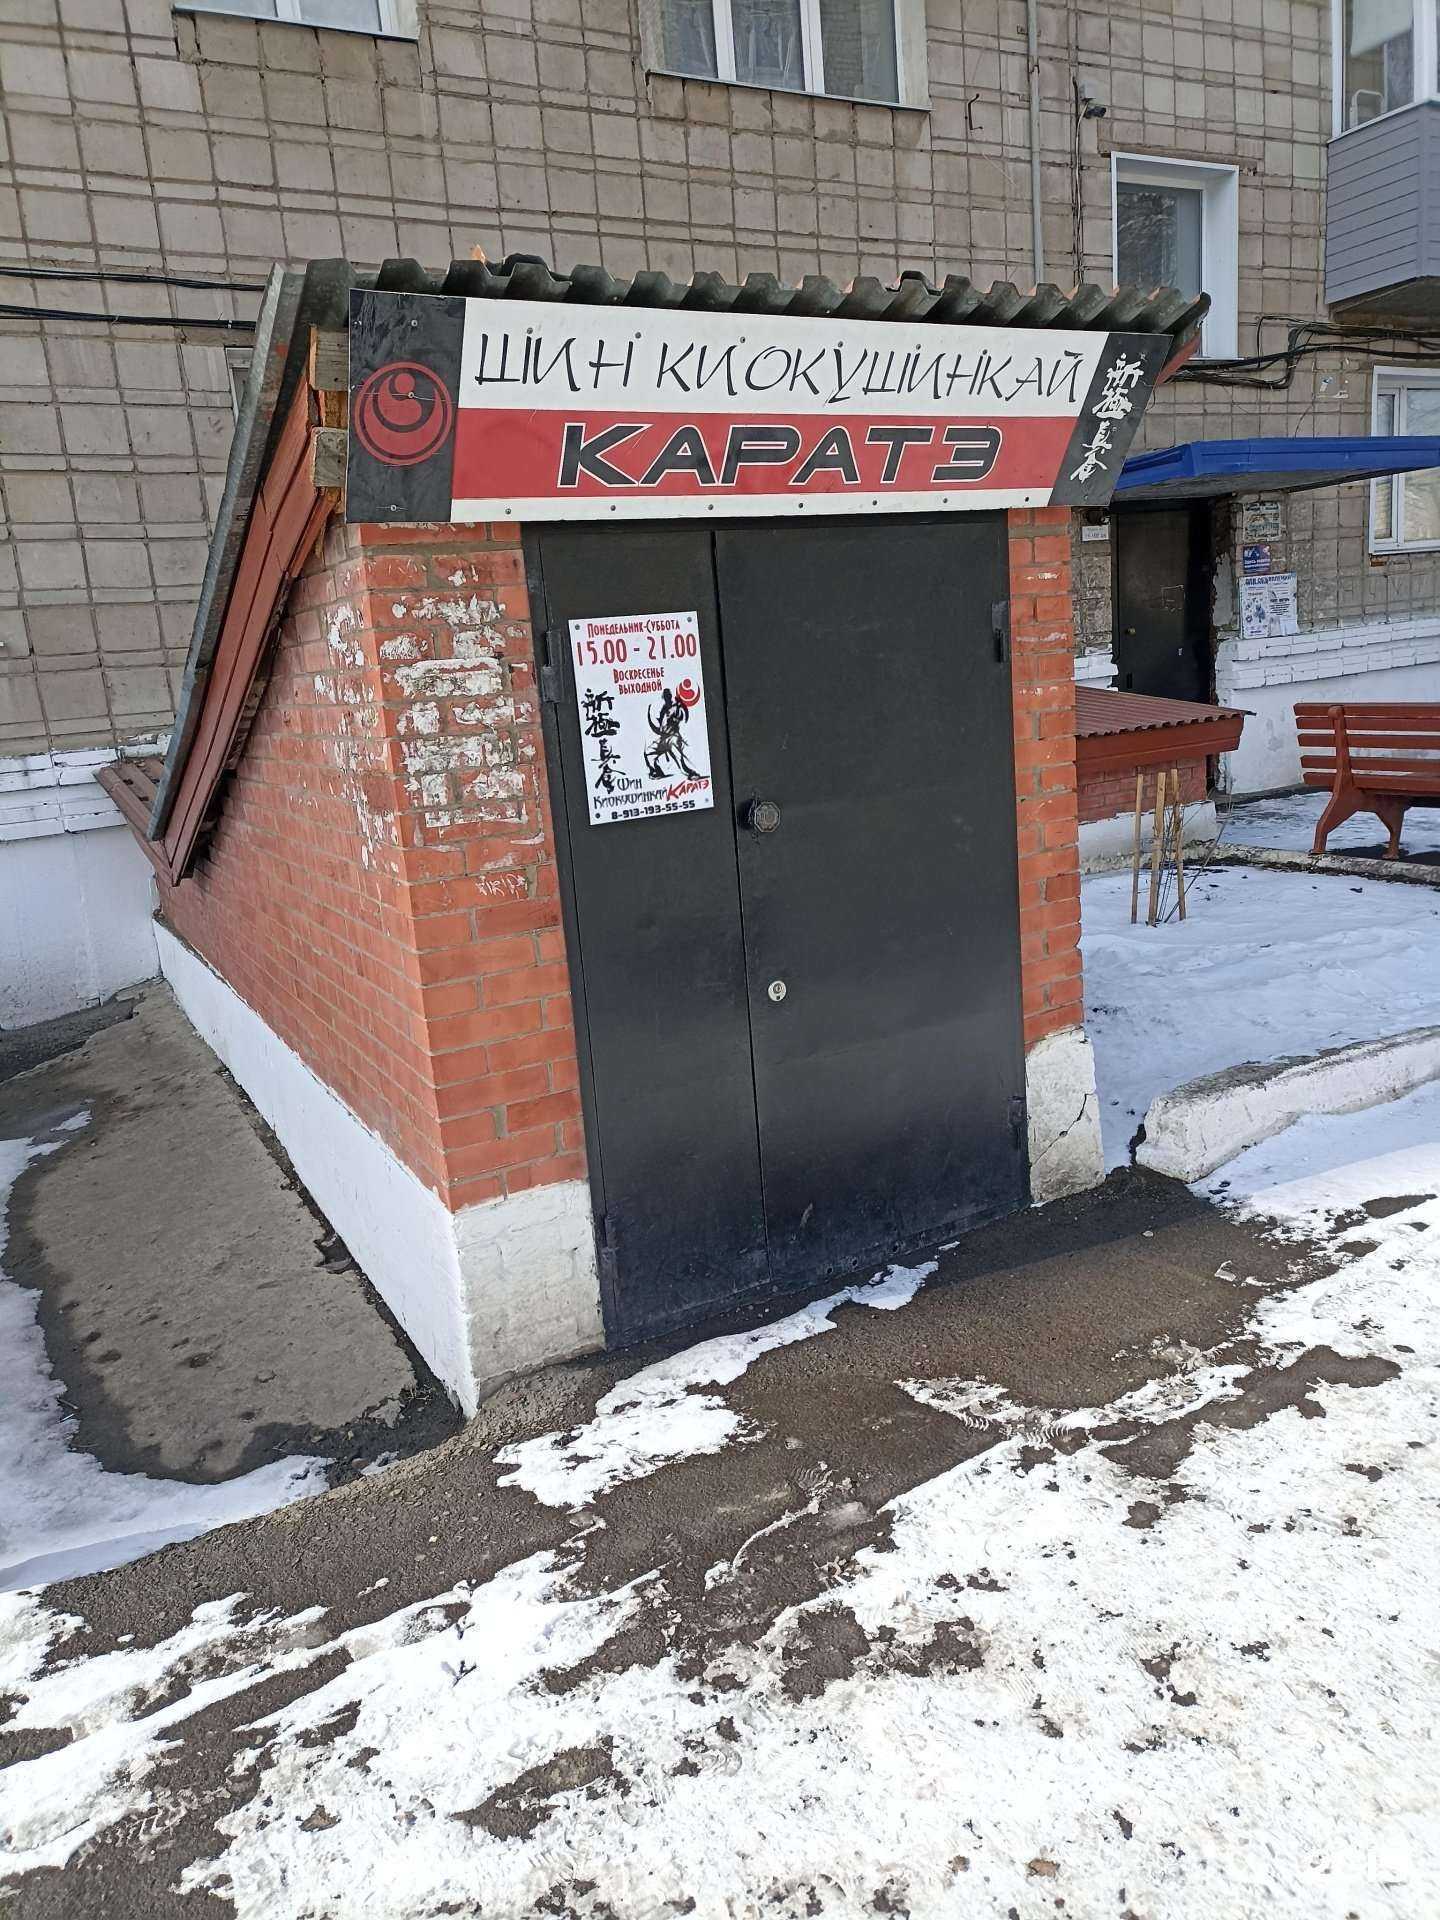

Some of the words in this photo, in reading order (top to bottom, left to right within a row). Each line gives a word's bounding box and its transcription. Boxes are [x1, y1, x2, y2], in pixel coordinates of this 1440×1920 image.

[475, 333, 634, 392] ШИН
[656, 341, 1084, 403] КИОКУШИНКАЙ
[557, 423, 1003, 488] КАРАТЭ
[576, 639, 628, 666] 15.00
[646, 633, 697, 660] 21.00
[613, 667, 665, 683] ВОСКРЕСЕНЬЕ
[619, 679, 663, 695] ВЫХОДНОЙ
[617, 778, 642, 791] ШИН
[666, 779, 710, 801] КАРАТЭ
[611, 800, 696, 820] 8-913-193-55-55
